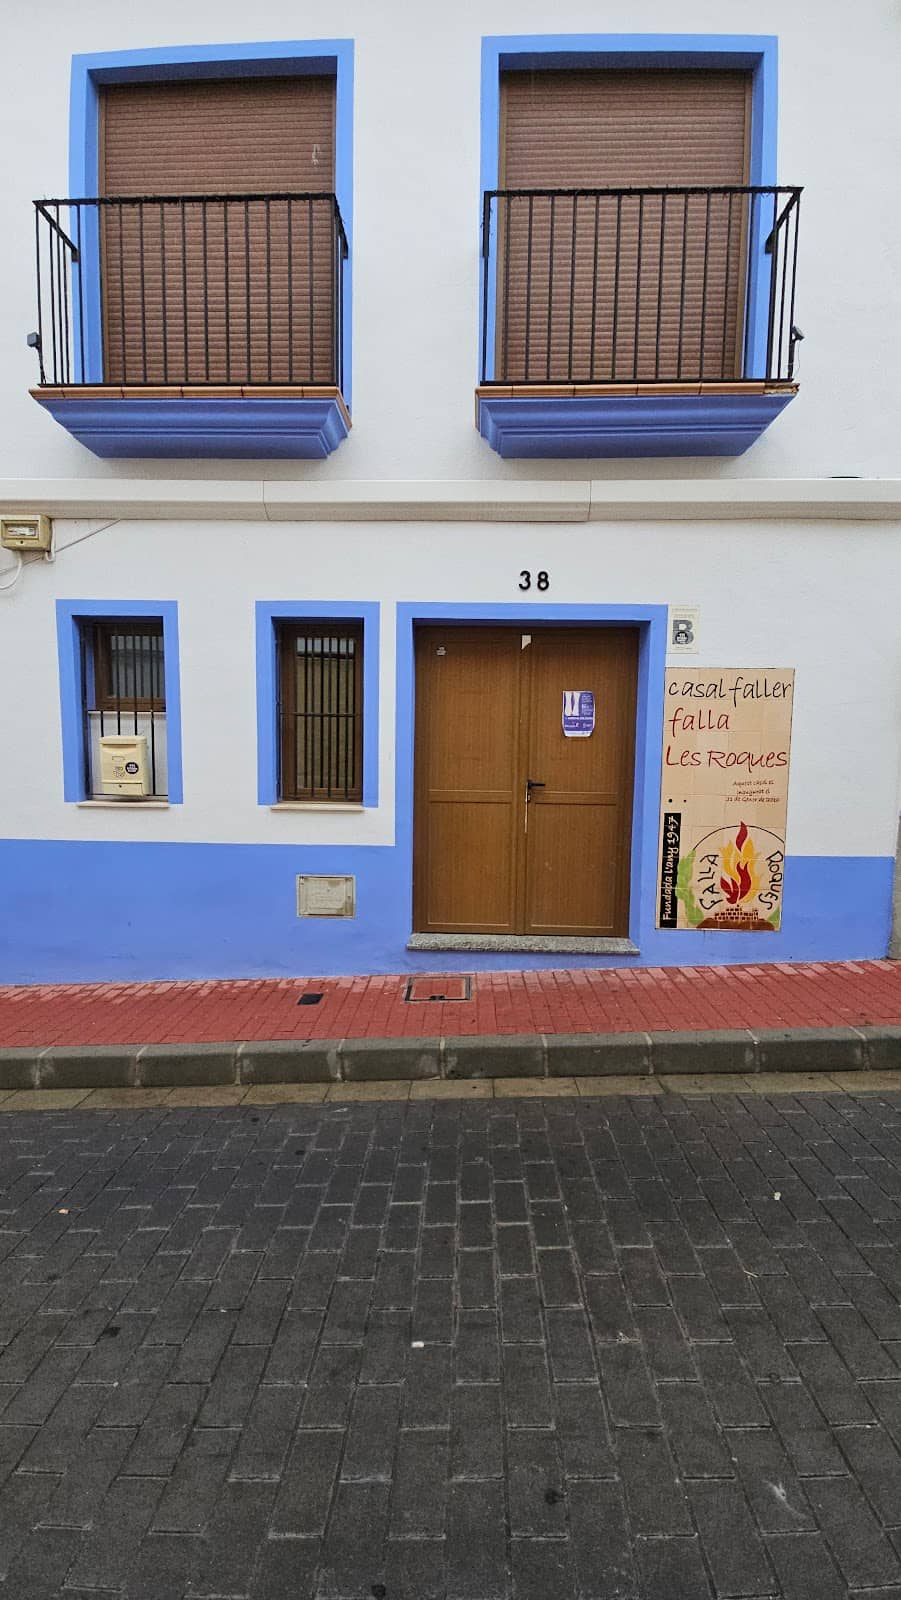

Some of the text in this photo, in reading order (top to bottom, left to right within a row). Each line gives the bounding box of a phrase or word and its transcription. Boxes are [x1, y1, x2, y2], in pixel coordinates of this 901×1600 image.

[518, 570, 550, 591] 38
[672, 619, 694, 645] B
[668, 676, 792, 708] casal faller
[668, 707, 730, 738] falla
[665, 745, 788, 774] Les Roques
[666, 815, 679, 845] 1947
[758, 850, 784, 910] ROQUES
[662, 876, 673, 921] Fundada
